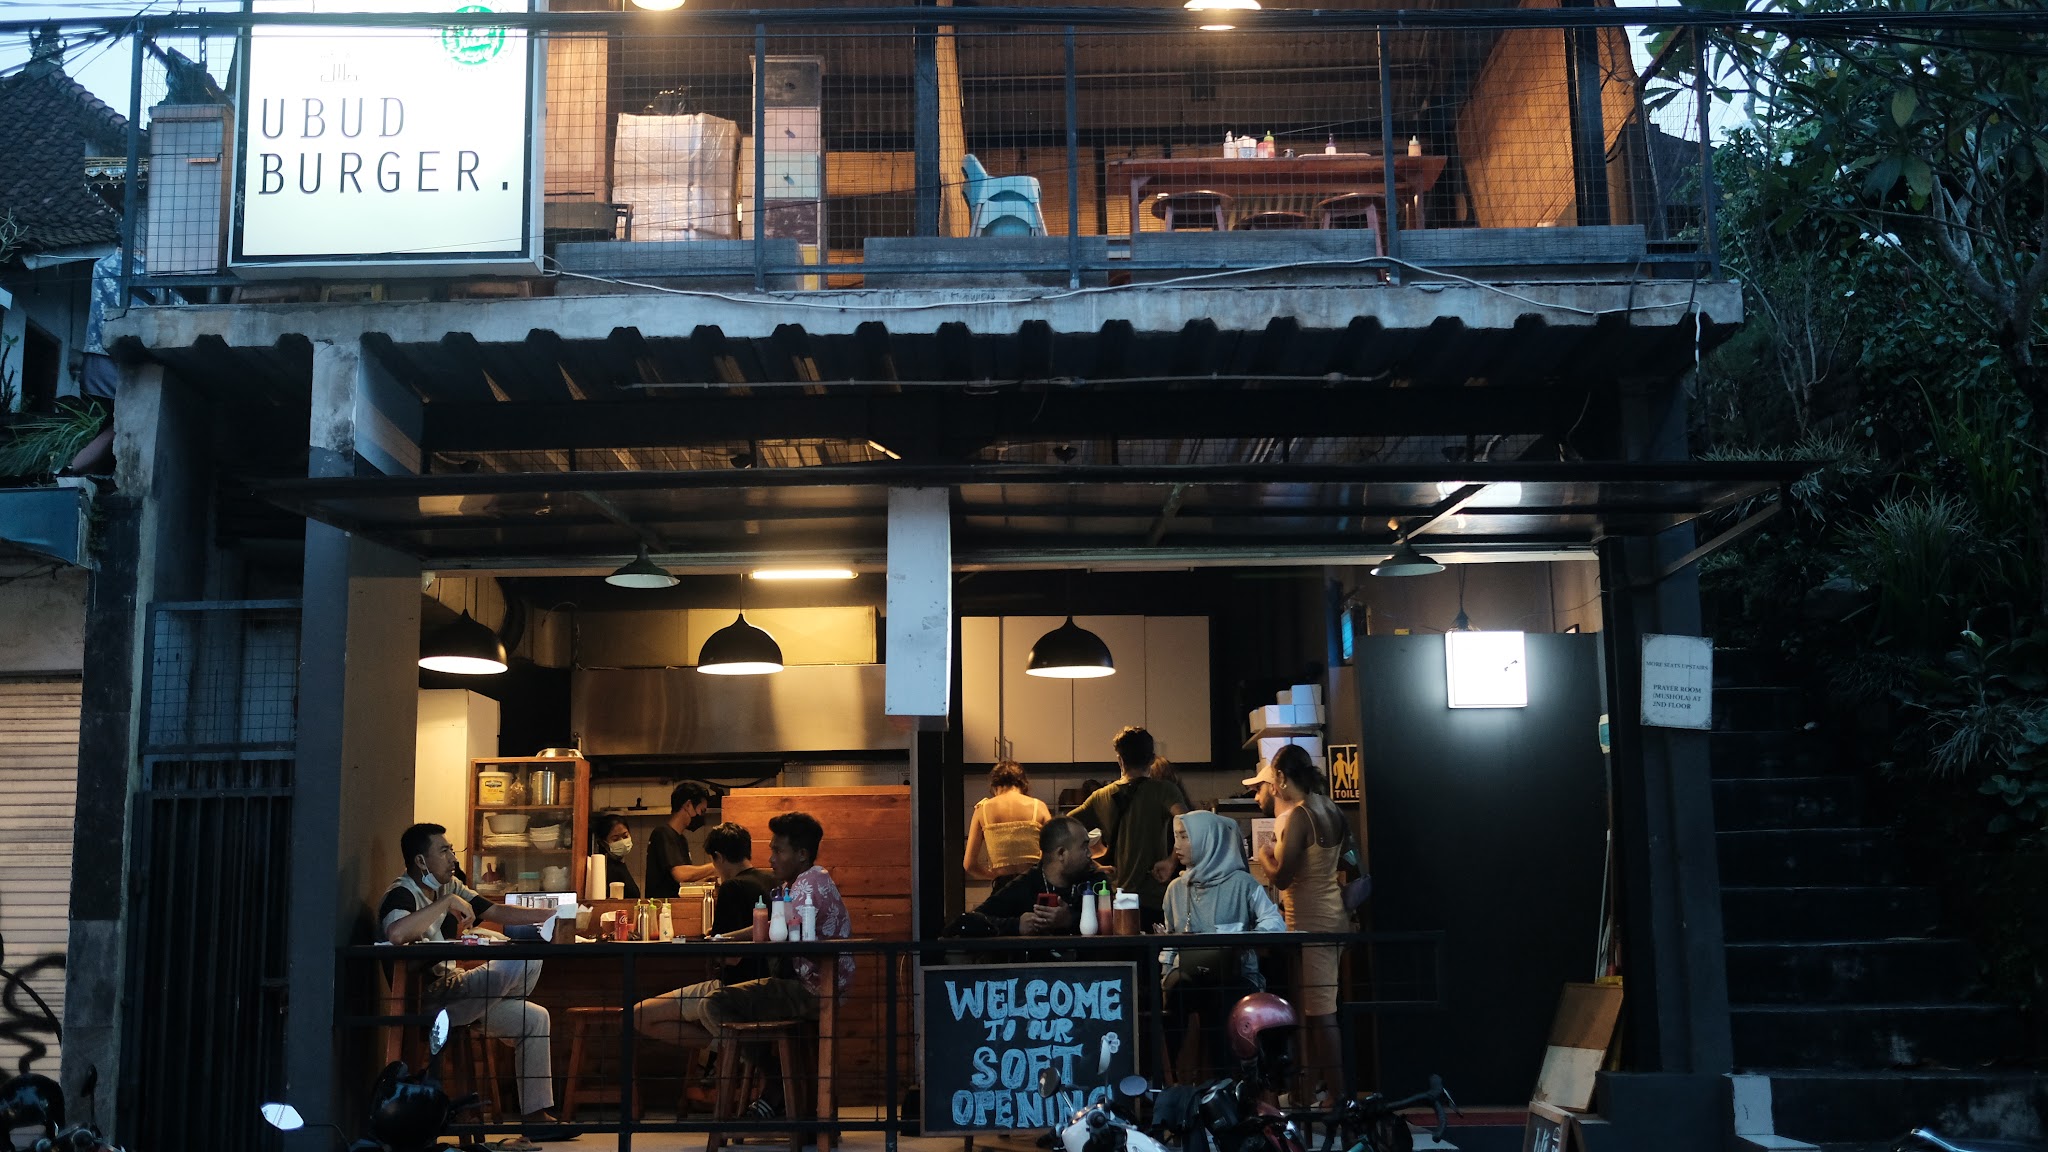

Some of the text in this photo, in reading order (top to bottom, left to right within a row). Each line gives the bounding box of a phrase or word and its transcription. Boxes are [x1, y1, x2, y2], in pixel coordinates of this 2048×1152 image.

[261, 97, 404, 140] UBUD
[1653, 684, 1679, 692] PRAYER
[1653, 693, 1691, 701] (MUSHOLA)
[1334, 790, 1360, 798] TOILE
[944, 977, 1122, 1022] WELCOME
[983, 1017, 1074, 1043] TO OUR
[971, 1043, 1084, 1092] SOFT
